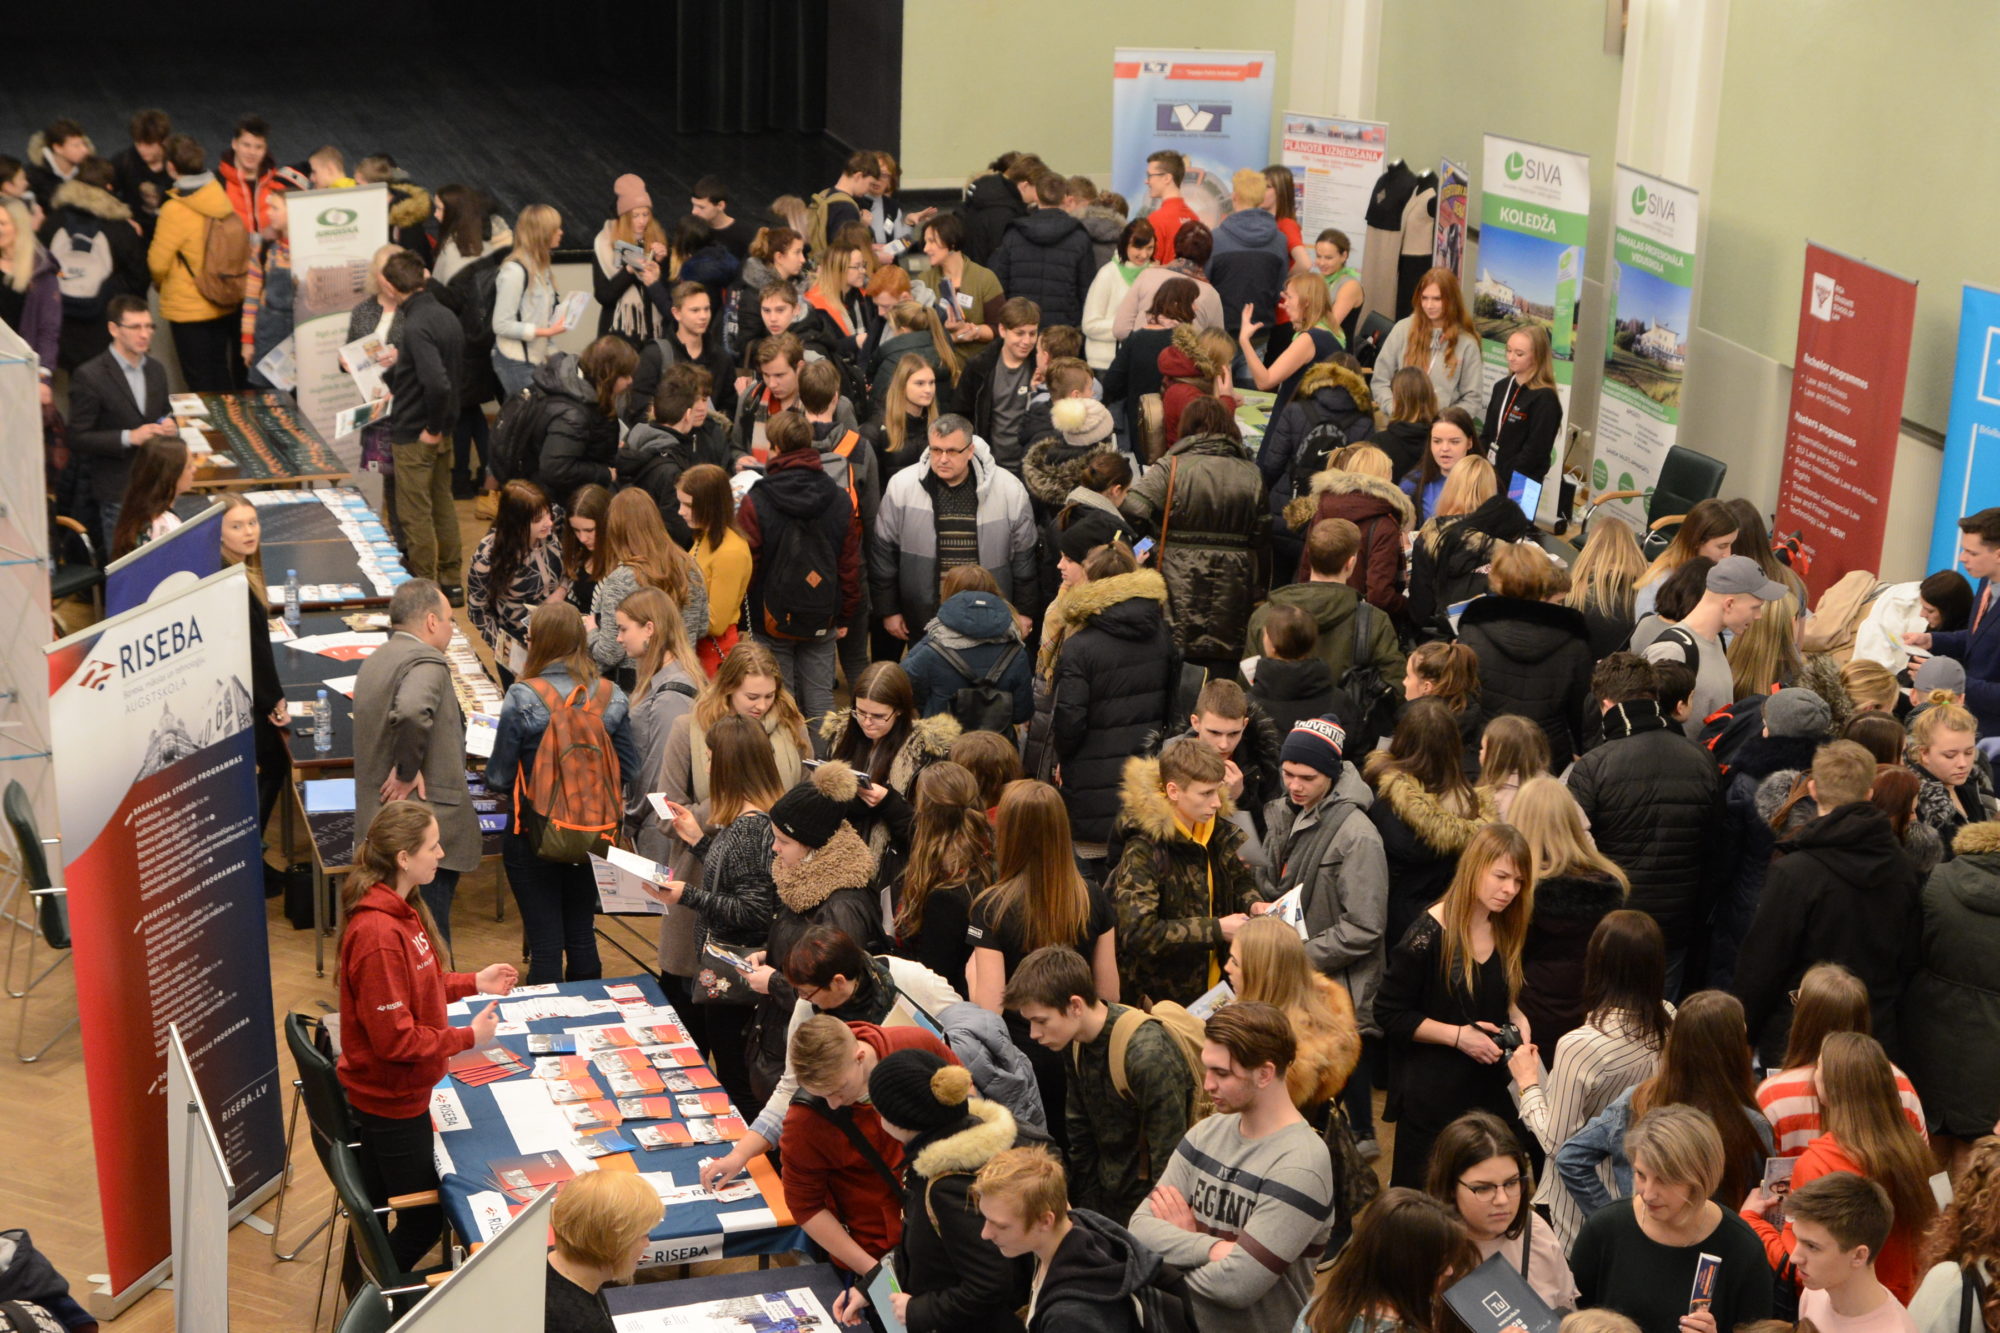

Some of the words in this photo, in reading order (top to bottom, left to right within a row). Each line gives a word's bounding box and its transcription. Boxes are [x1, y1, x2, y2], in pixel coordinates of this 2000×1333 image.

[1525, 159, 1562, 186] SIVA
[1500, 206, 1557, 234] KOLEDŽA
[1647, 193, 1676, 223] SIVA
[1803, 352, 1831, 372] Bachelor
[1829, 365, 1869, 389] programmes
[1794, 410, 1819, 430] Masters
[1818, 422, 1857, 448] programmes
[119, 614, 203, 679] RISEBA
[133, 789, 171, 816] BAKALAURA
[197, 752, 243, 783] PROGRAMMAS
[201, 858, 245, 890] PROGRAMMAS
[213, 1016, 250, 1046] PROGRAMMA
[221, 1083, 268, 1122] RISEBA.LV
[440, 1103, 459, 1127] RISEBA
[654, 1245, 709, 1264] RISEBA
